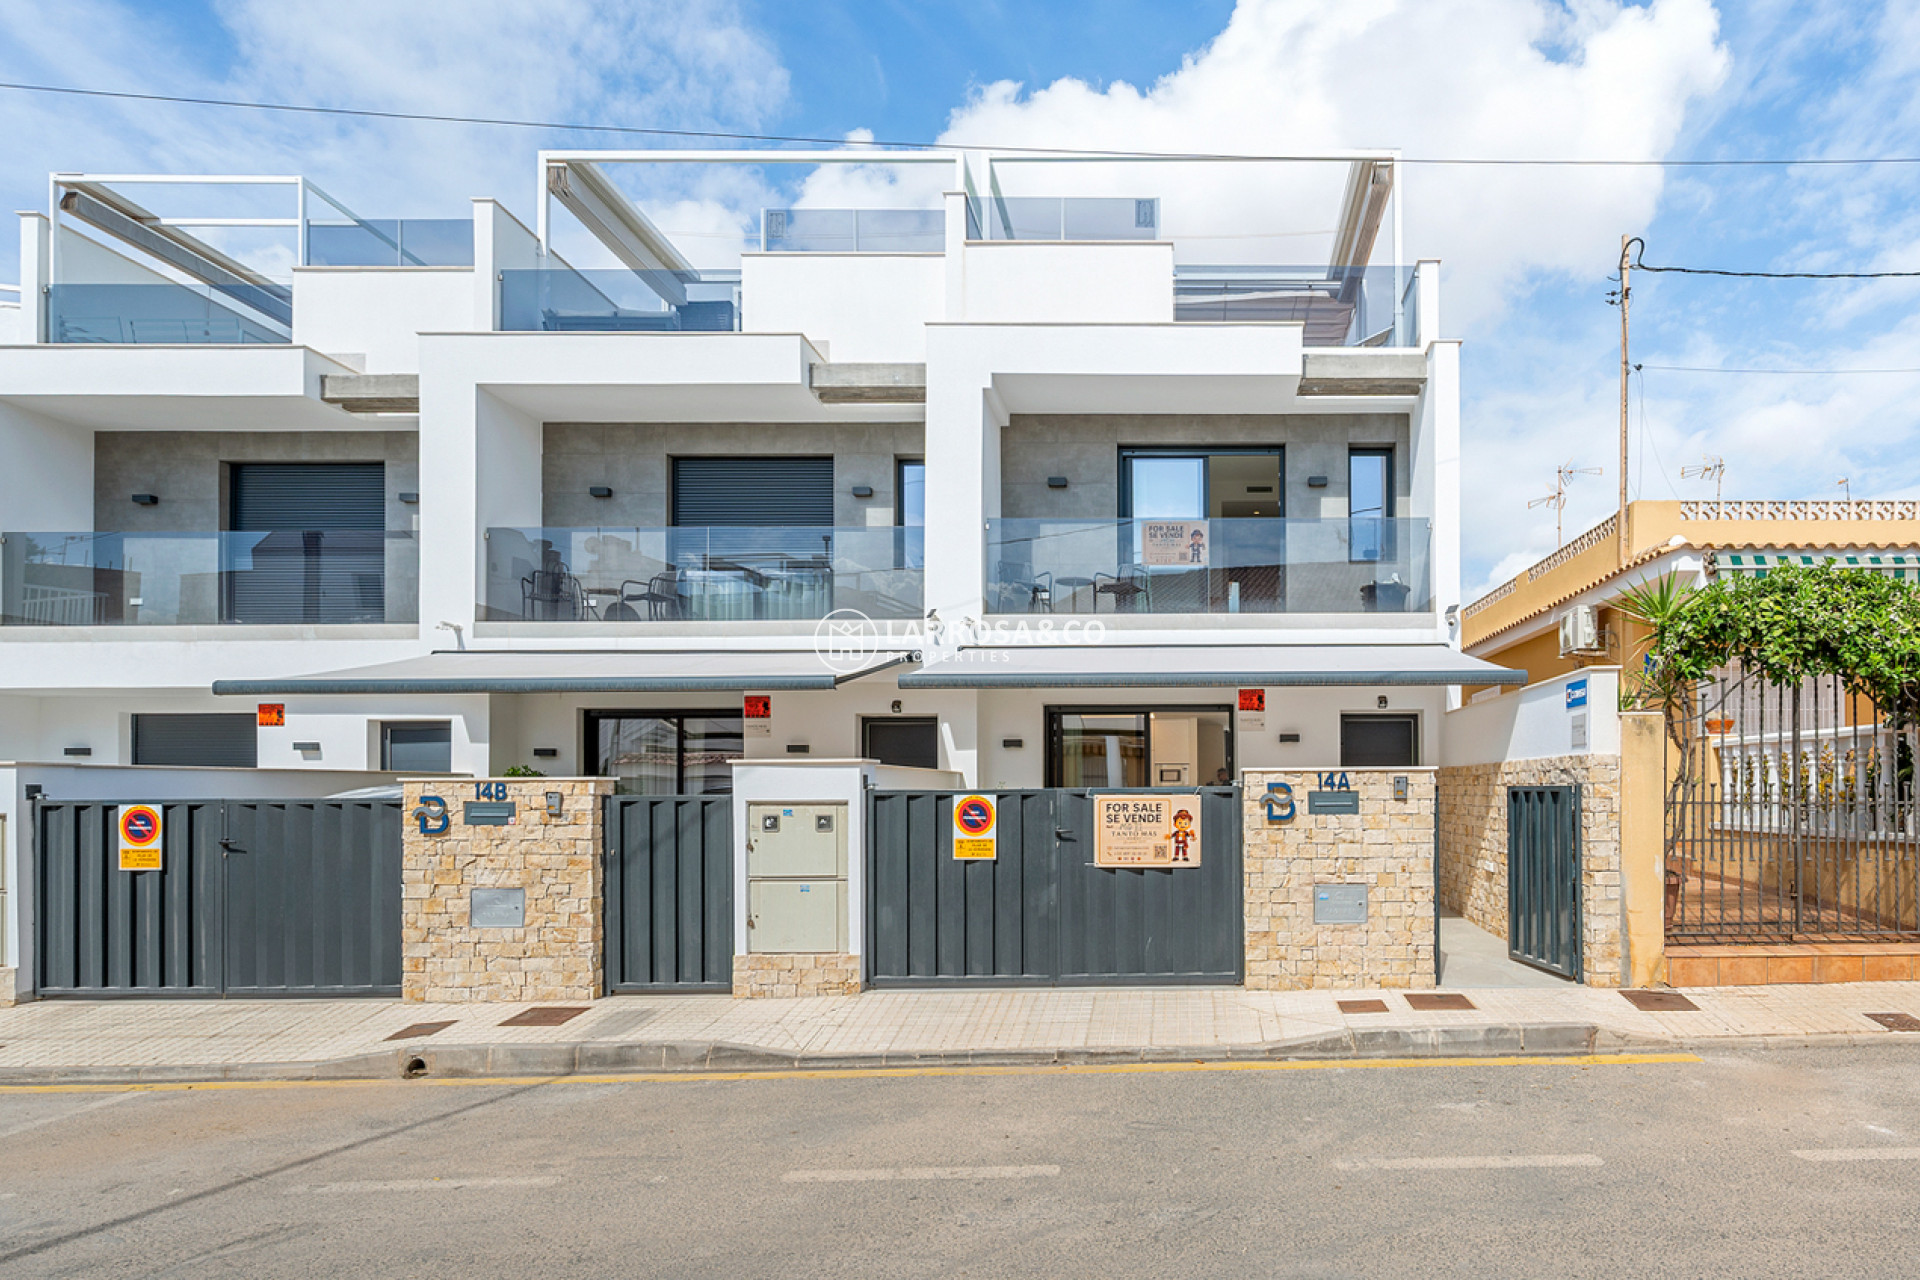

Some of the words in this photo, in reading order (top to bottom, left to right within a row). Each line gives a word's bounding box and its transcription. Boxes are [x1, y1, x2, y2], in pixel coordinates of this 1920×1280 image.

[1317, 771, 1351, 790] 14A
[475, 782, 508, 801] 14B
[1105, 803, 1129, 813] FOR
[1133, 803, 1162, 813] SALE
[1105, 814, 1120, 823] SE
[1123, 814, 1162, 823] VENDE
